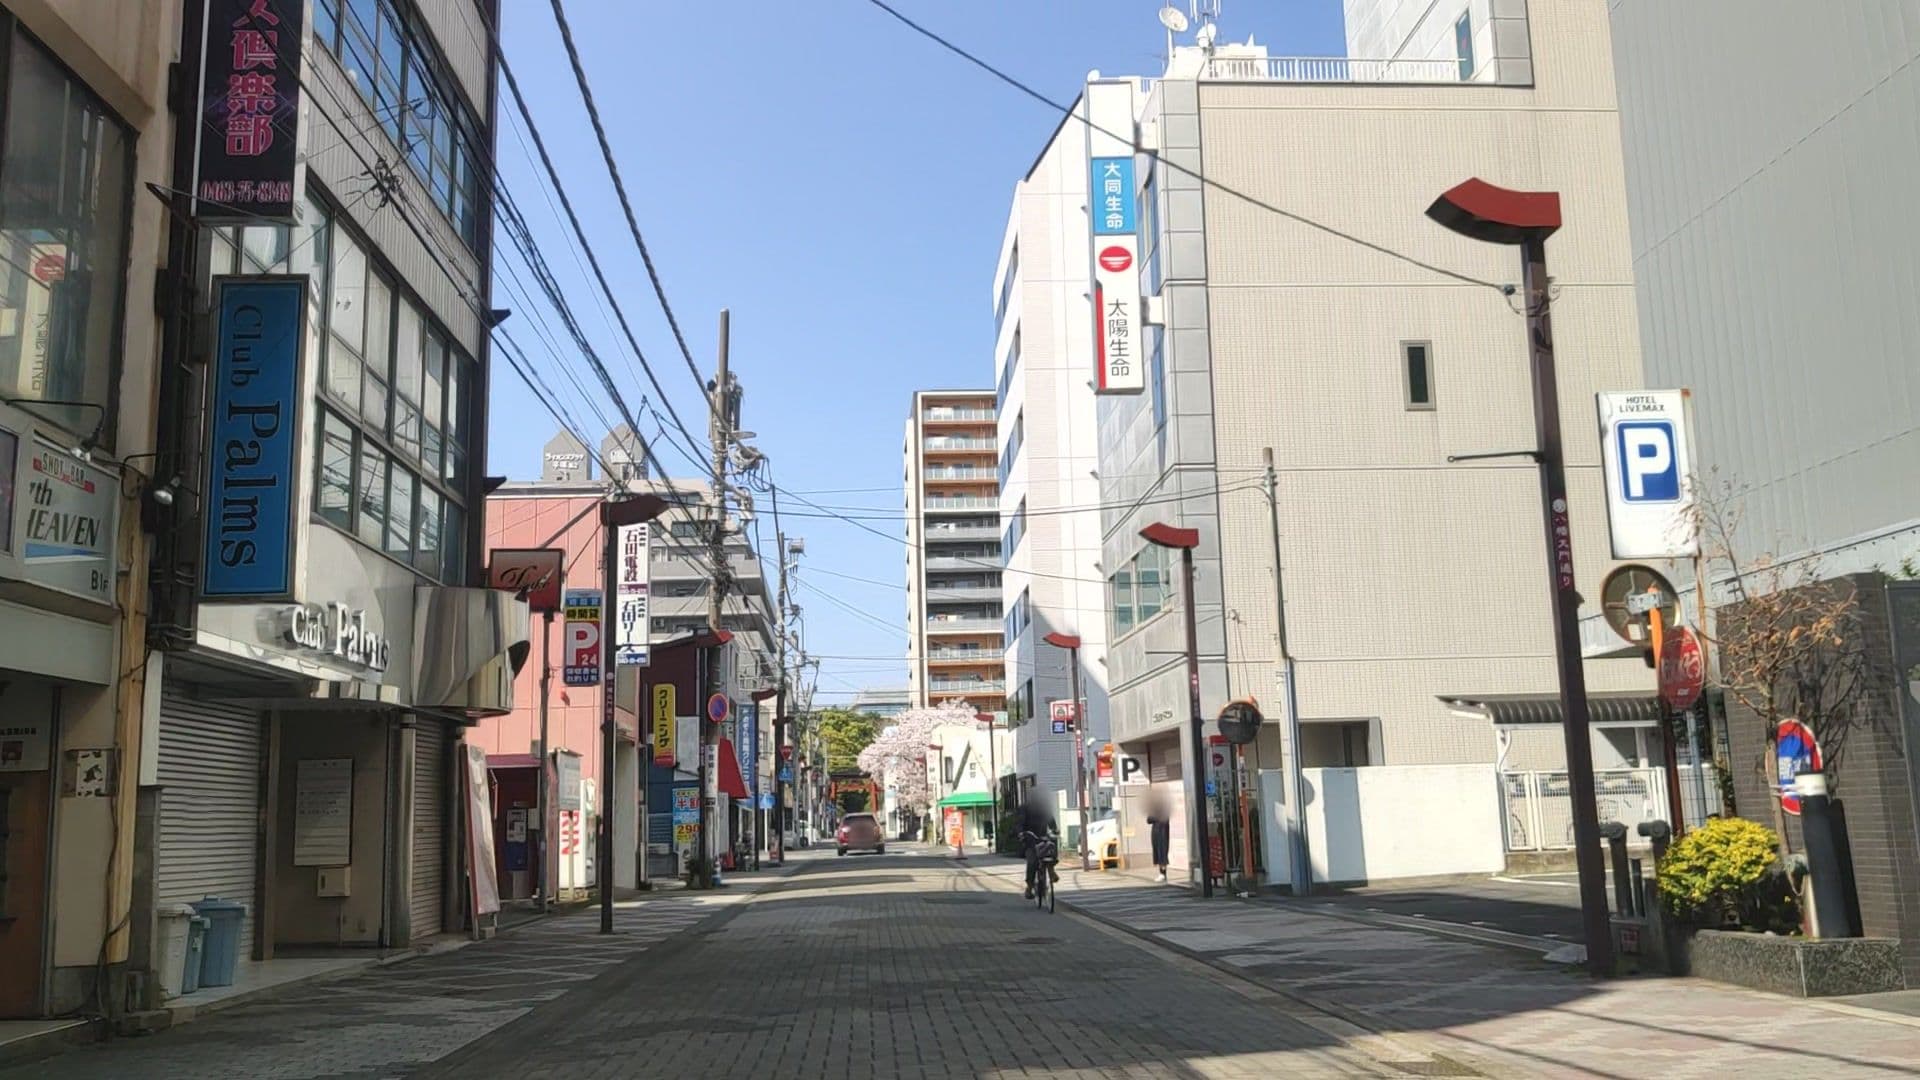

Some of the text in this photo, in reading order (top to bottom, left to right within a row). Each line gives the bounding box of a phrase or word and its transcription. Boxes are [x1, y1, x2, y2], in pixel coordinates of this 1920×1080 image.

[1103, 162, 1125, 229] 大同生命
[1108, 298, 1130, 377] 太陽生命
[1619, 404, 1665, 413] LIVEMAX
[1626, 396, 1657, 404] HOTEL
[220, 304, 281, 569] Club Palms
[42, 452, 85, 485] SHOT BAR
[1623, 427, 1671, 497] P
[624, 529, 638, 582] 石田電設
[91, 570, 109, 593] B1F
[292, 601, 390, 673] Club Palms
[566, 622, 599, 666] P
[581, 654, 598, 665] 24
[659, 689, 670, 748] クリーニング
[1121, 757, 1141, 782] P
